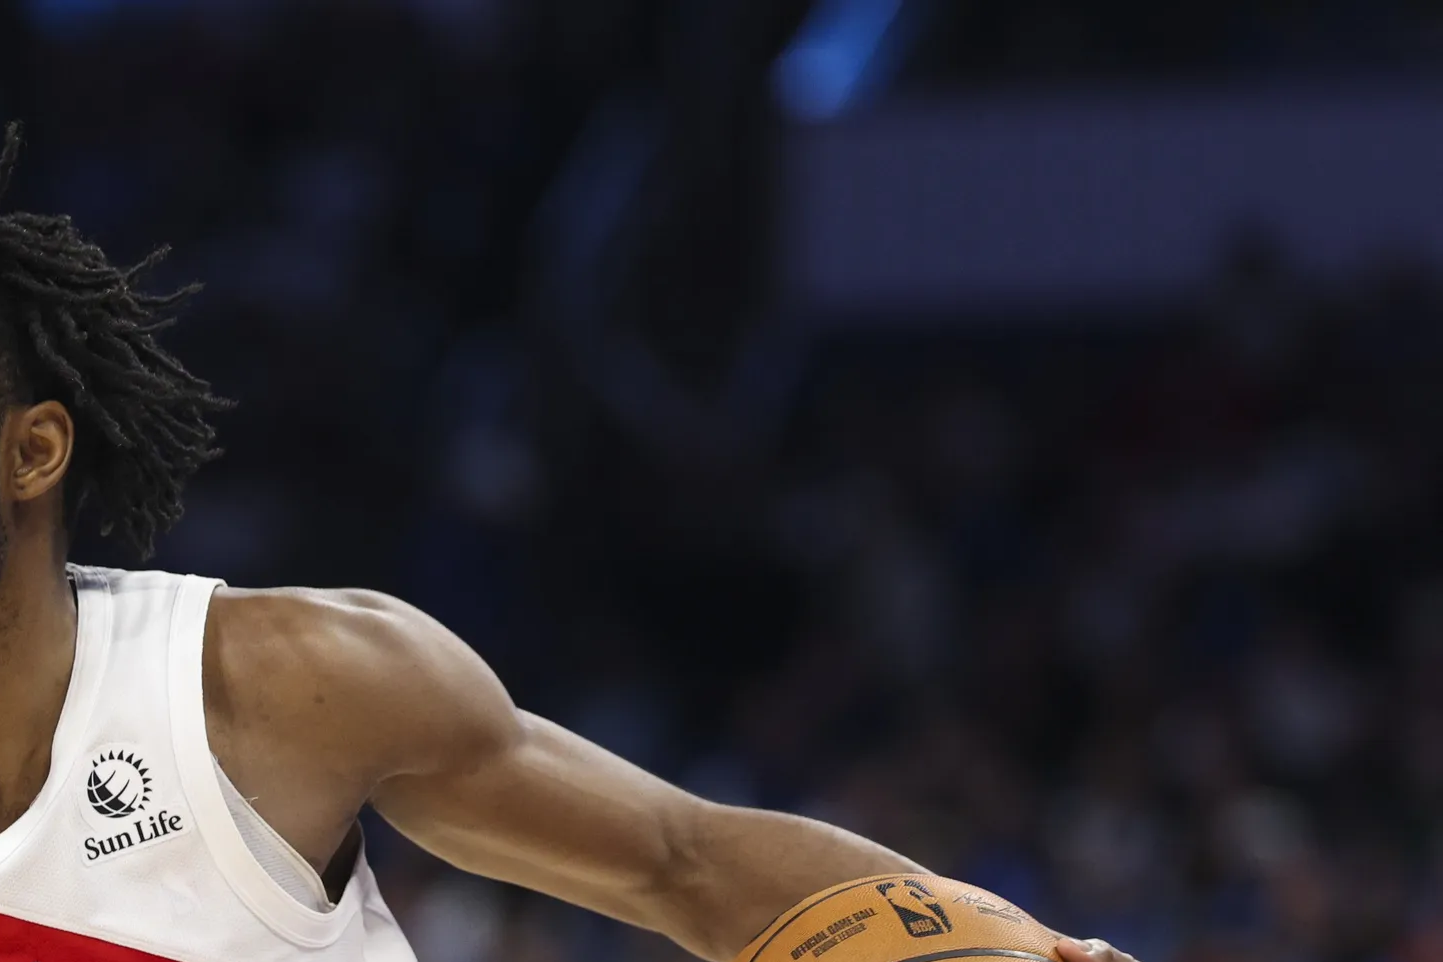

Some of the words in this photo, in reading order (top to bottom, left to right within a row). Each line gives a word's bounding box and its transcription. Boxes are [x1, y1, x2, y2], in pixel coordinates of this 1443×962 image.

[84, 837, 134, 860] Sun
[133, 810, 183, 843] Life
[791, 930, 829, 960] OFFICIAL
[827, 916, 854, 934] GAME
[852, 908, 878, 921] BALL
[909, 919, 936, 934] NBA
